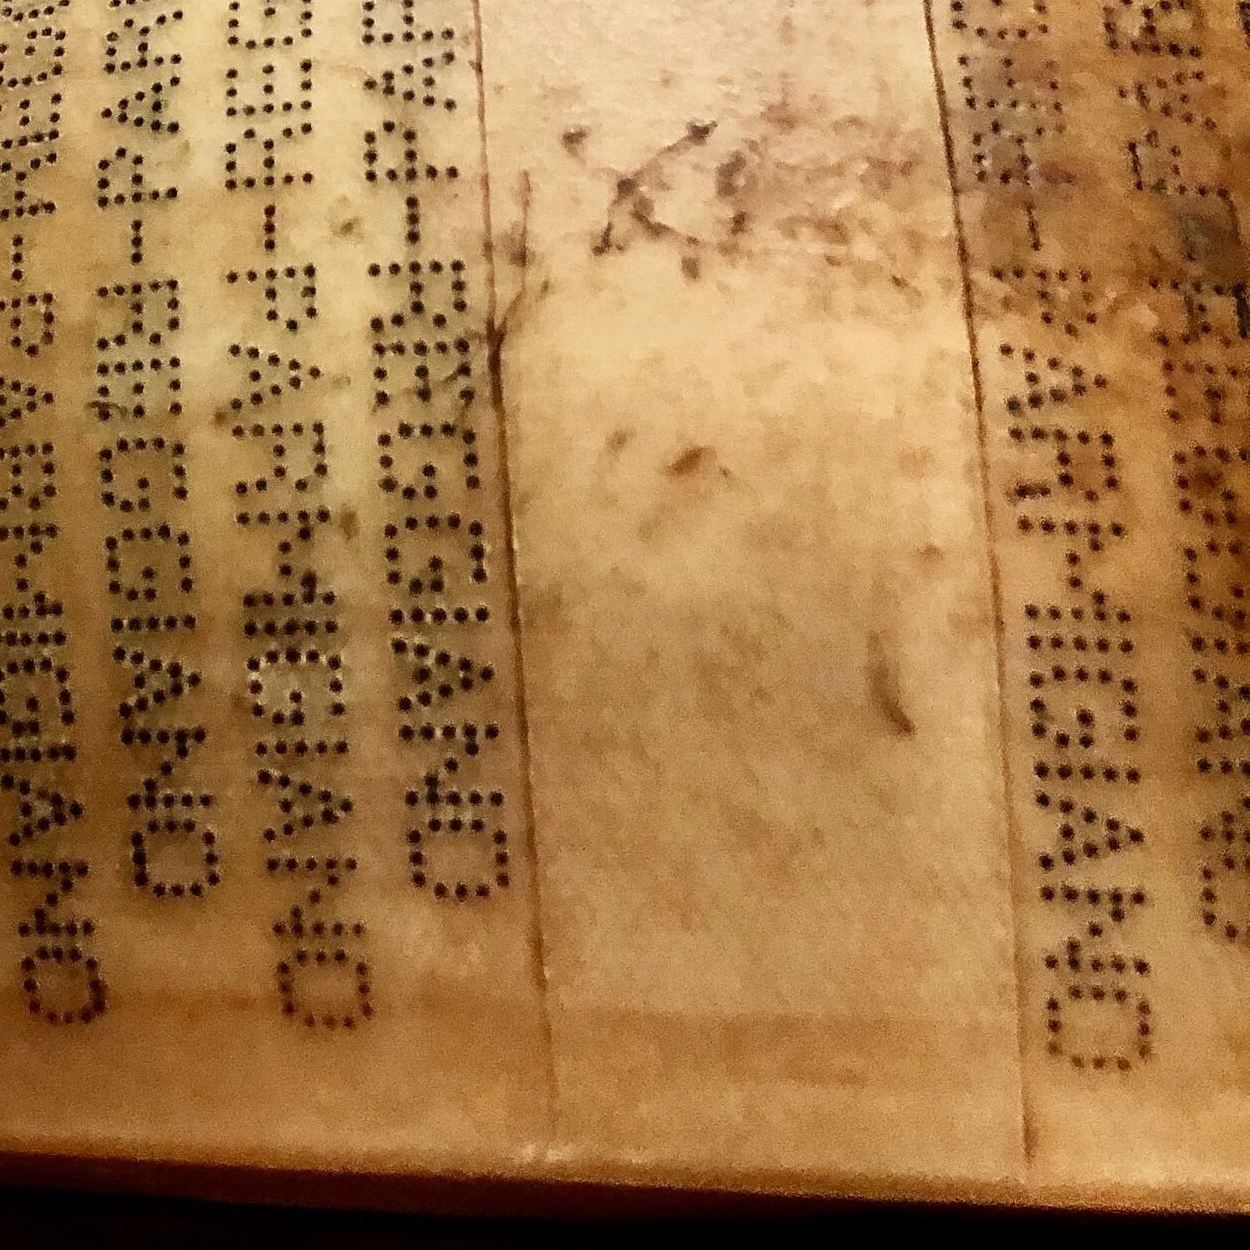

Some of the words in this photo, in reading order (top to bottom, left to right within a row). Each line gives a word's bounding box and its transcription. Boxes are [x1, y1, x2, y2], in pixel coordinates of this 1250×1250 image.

[96, 278, 222, 899] REGGIANO
[225, 264, 375, 1030] PARMIGIANO
[365, 259, 512, 900] REGGIANO
